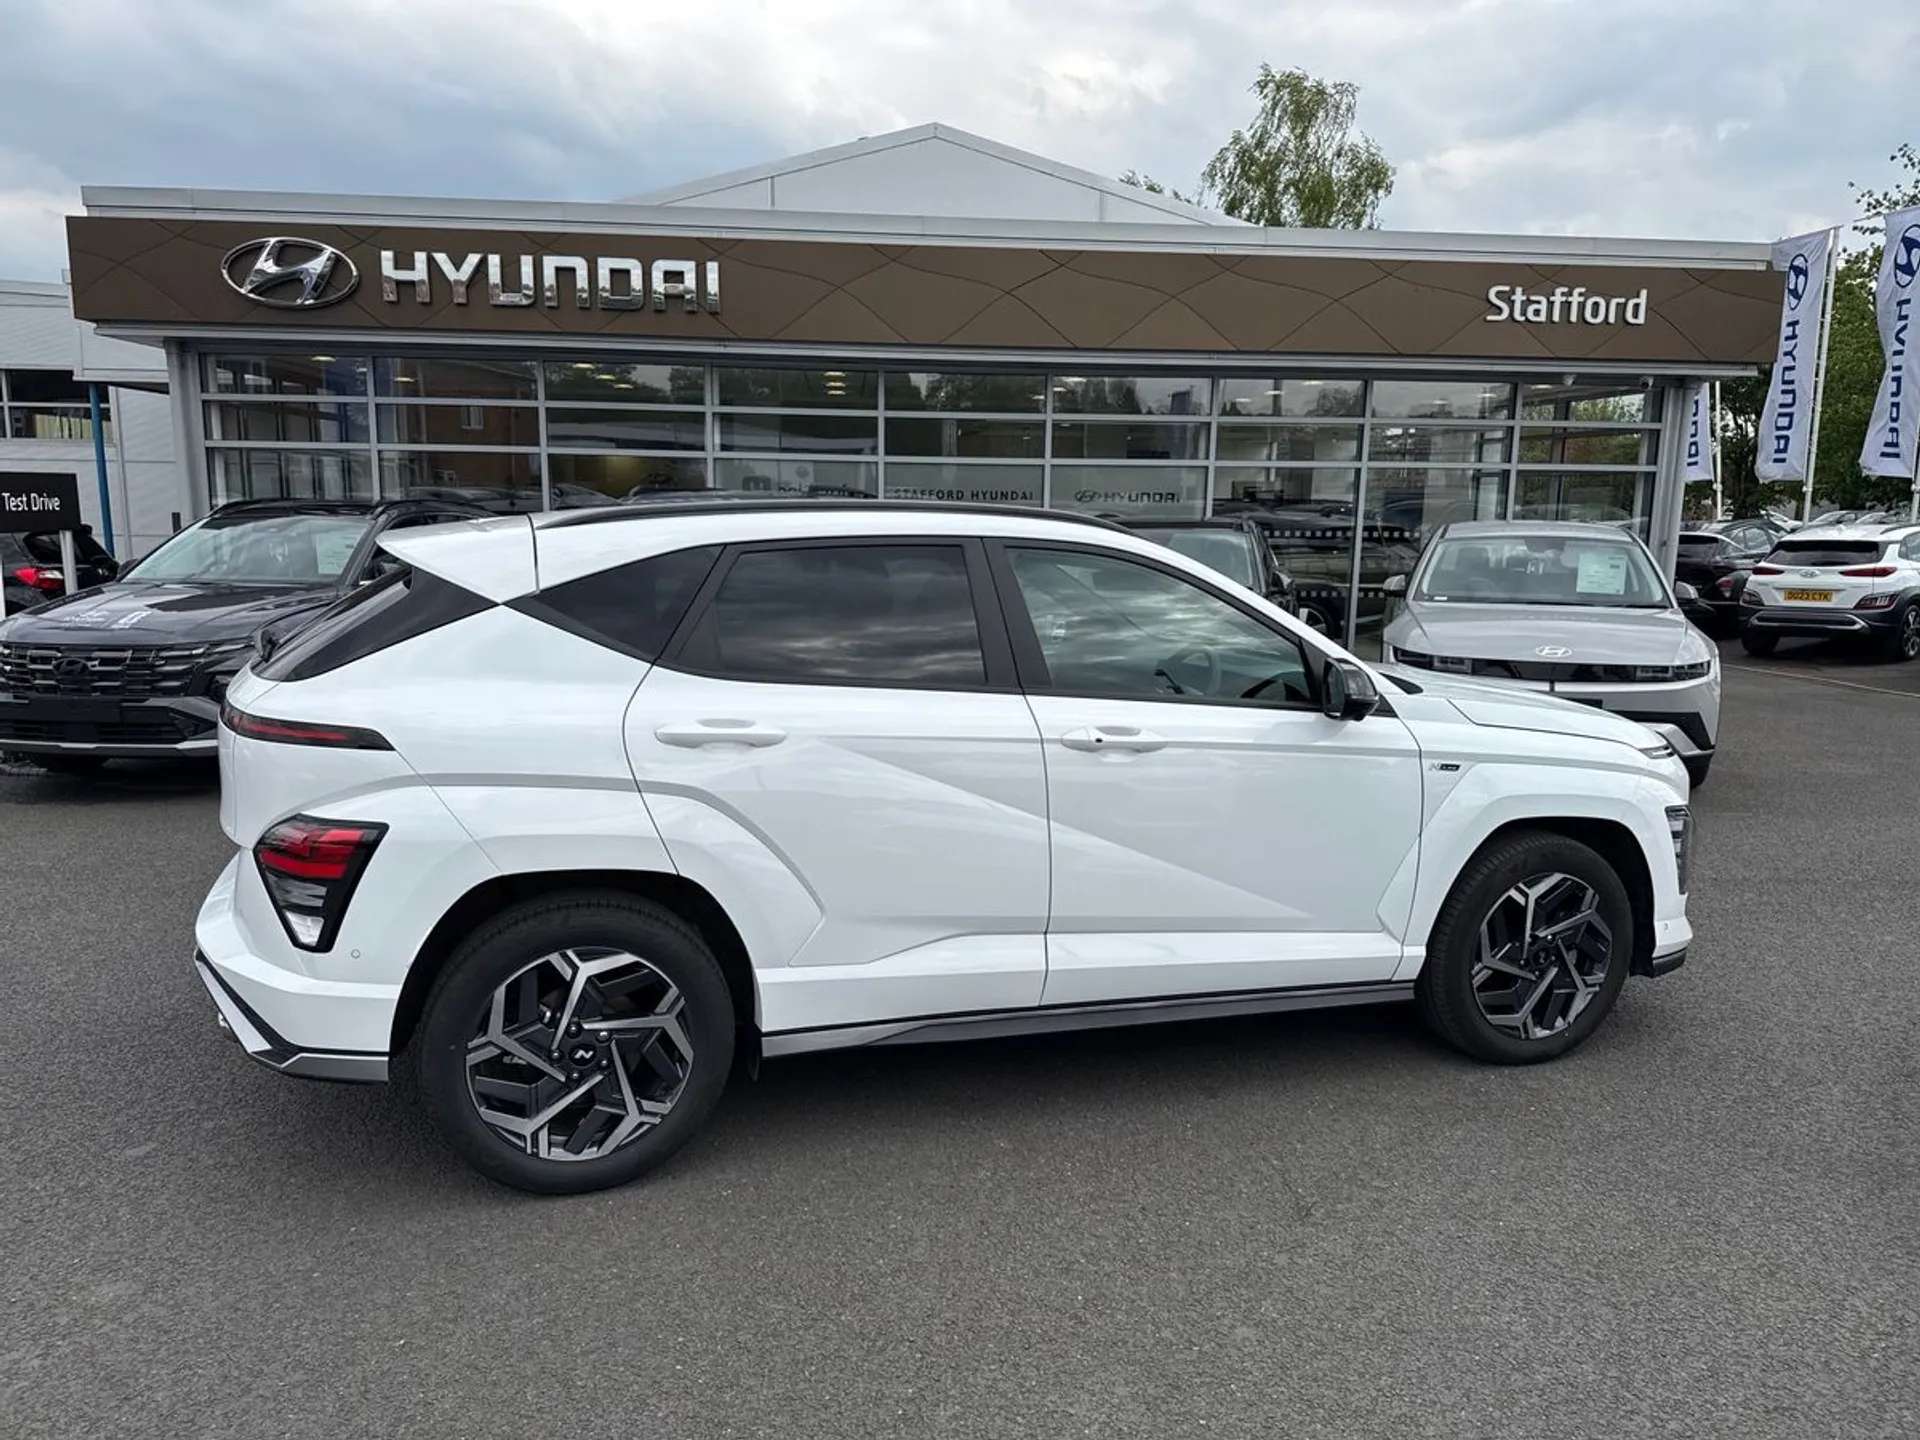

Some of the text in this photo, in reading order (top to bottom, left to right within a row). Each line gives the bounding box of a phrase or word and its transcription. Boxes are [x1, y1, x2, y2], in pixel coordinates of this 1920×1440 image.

[380, 250, 721, 314] HYUNDAI
[1486, 284, 1648, 325] Stafford
[1772, 319, 1800, 464] HYUNDAI
[1, 492, 61, 511] Test Drive
[893, 488, 1034, 501] STAFFORD HYUNDAI
[1103, 491, 1181, 504] HYUNDAI
